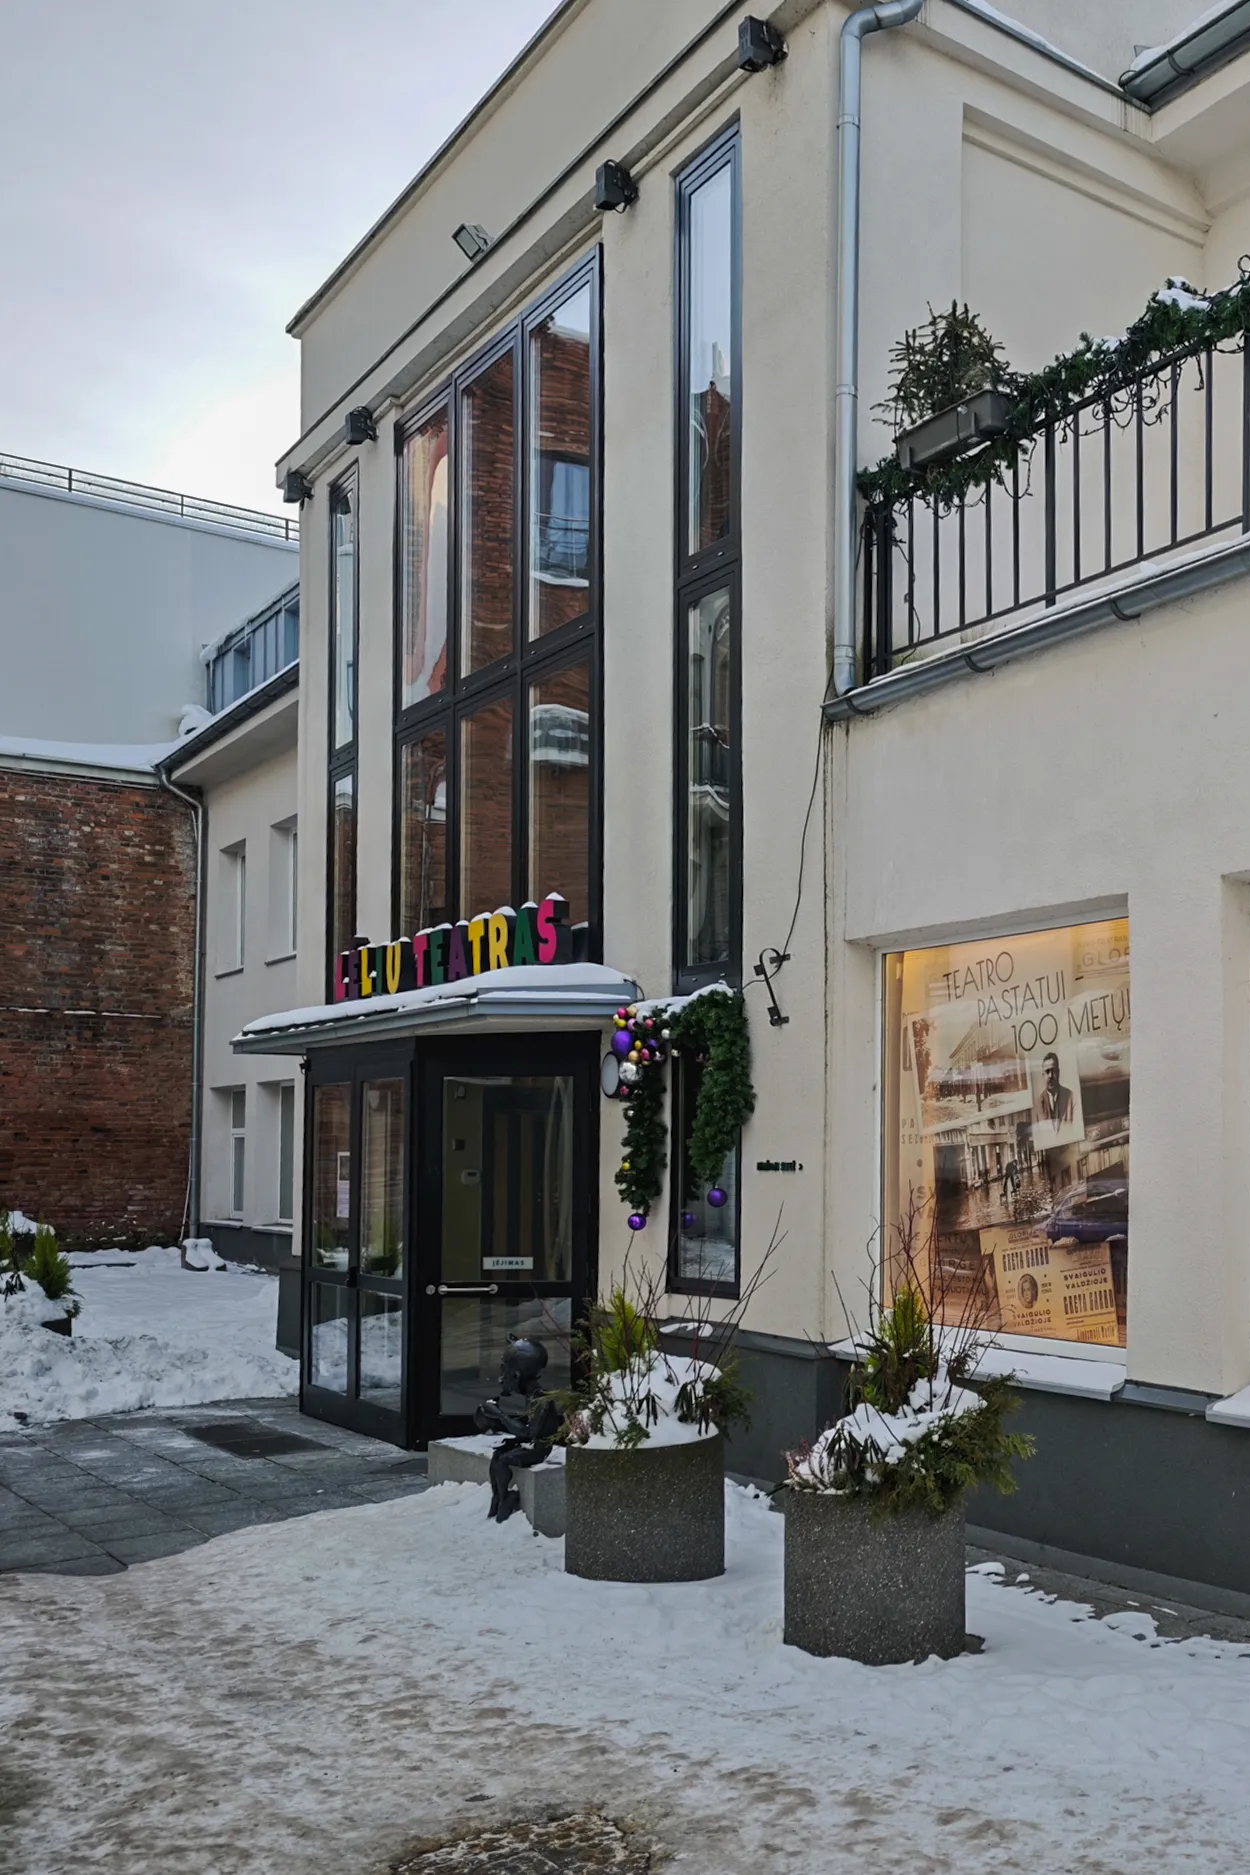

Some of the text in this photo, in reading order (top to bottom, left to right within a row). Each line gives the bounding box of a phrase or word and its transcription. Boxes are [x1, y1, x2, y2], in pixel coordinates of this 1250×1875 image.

[413, 899, 558, 987] TEATRAS
[943, 951, 1014, 1001] TEATRO
[977, 970, 1066, 1028] PASTATUI
[1011, 1013, 1059, 1054] 100
[1064, 1268, 1107, 1281] SVAIGULIO
[1065, 1277, 1109, 1290] VALDŽIOJE
